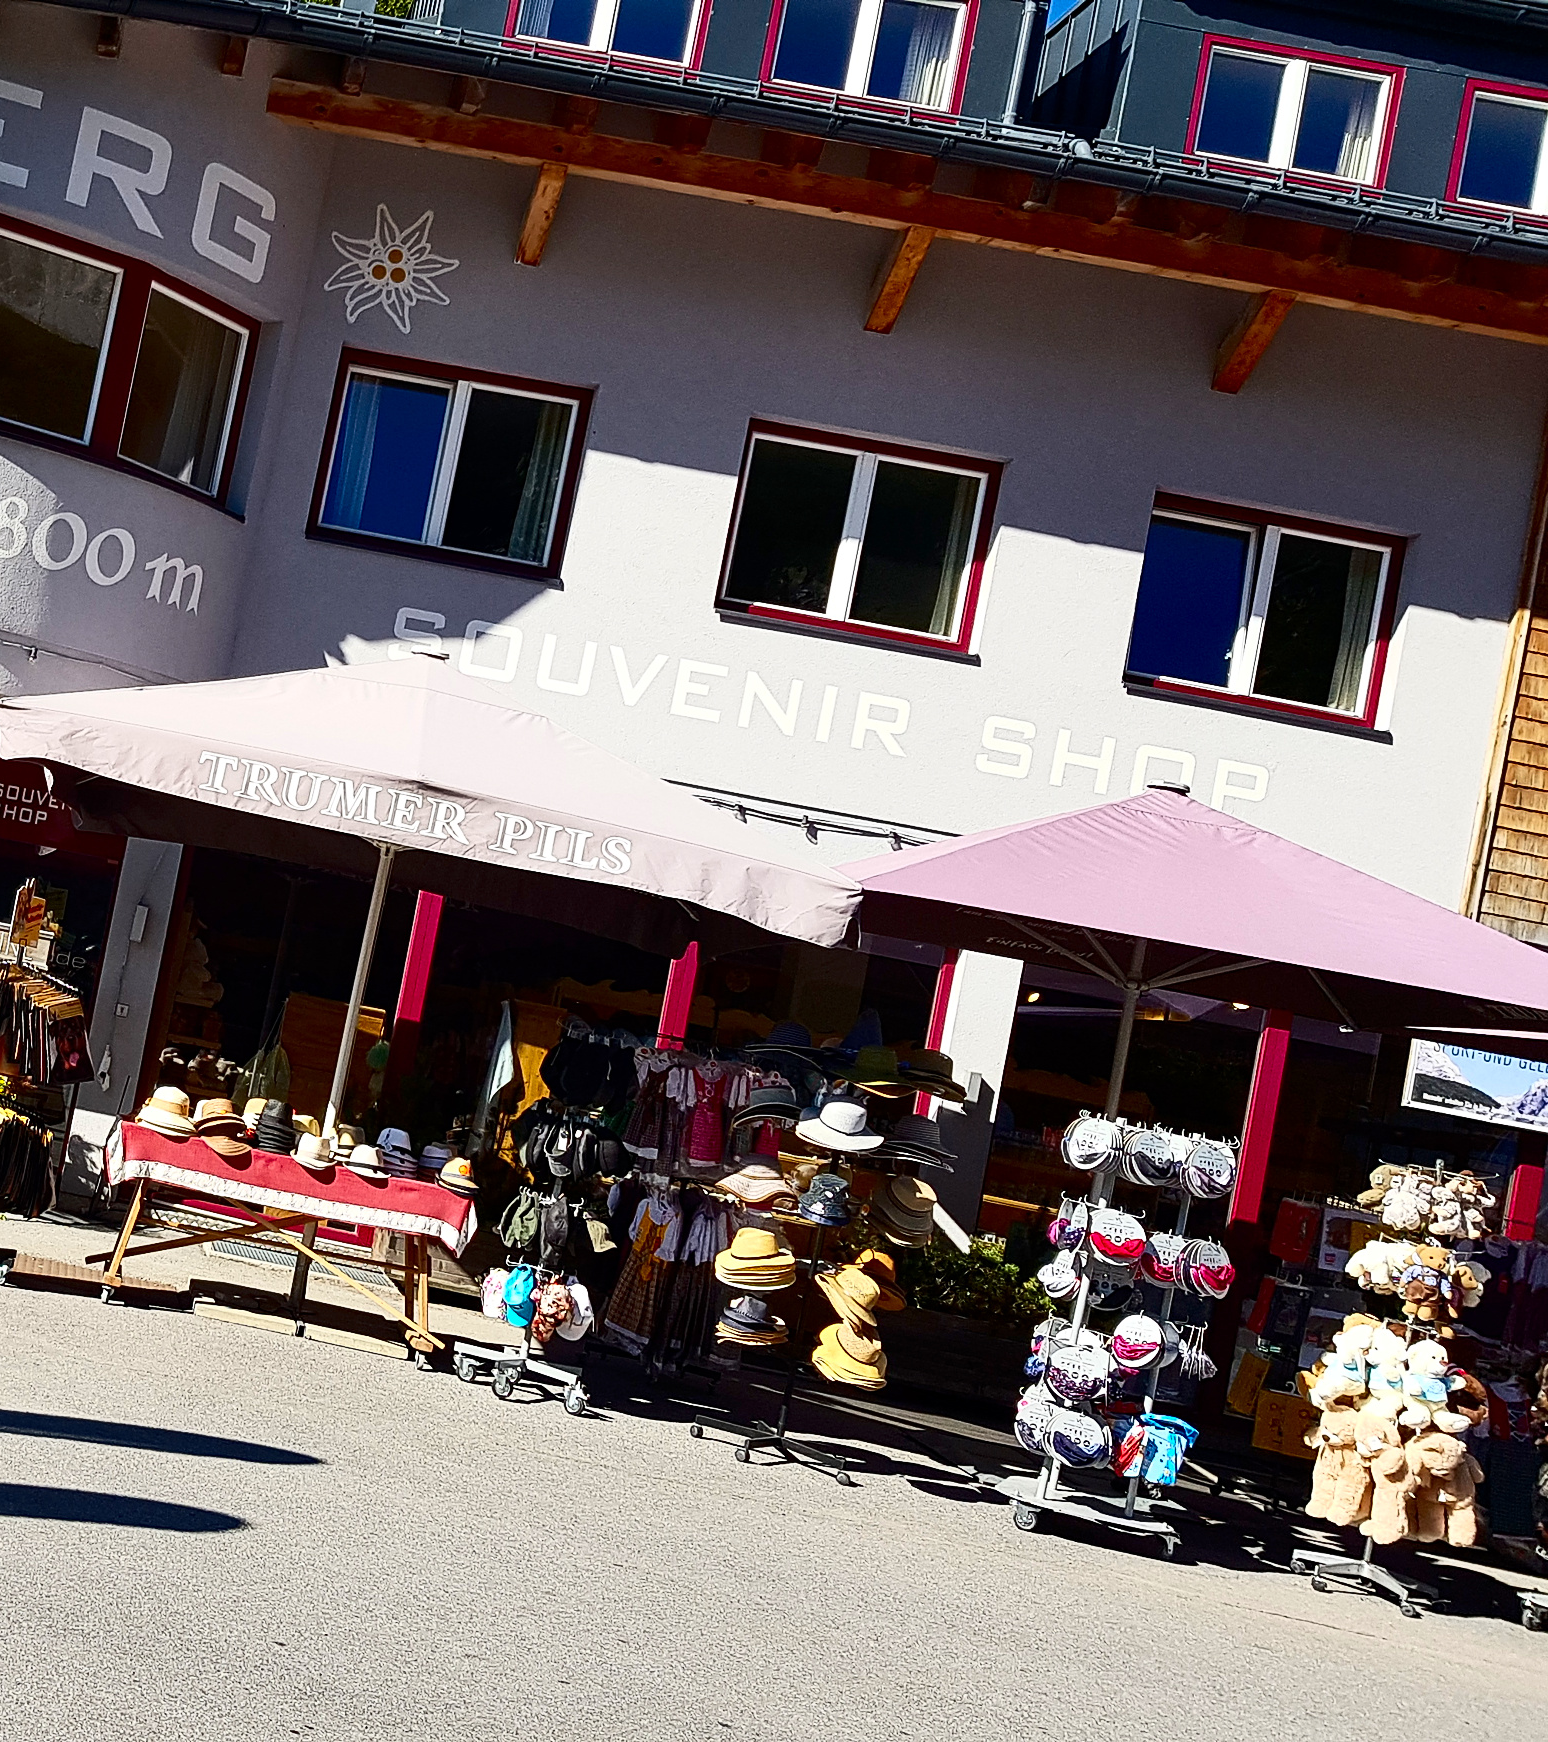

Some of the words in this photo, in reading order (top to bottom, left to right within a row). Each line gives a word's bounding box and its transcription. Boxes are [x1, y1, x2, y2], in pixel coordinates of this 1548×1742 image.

[142, 551, 205, 618] m
[388, 606, 913, 760] SOUVENIR
[974, 714, 1272, 814] SHOP
[198, 750, 470, 847] TRUMER
[492, 810, 633, 876] PILS
